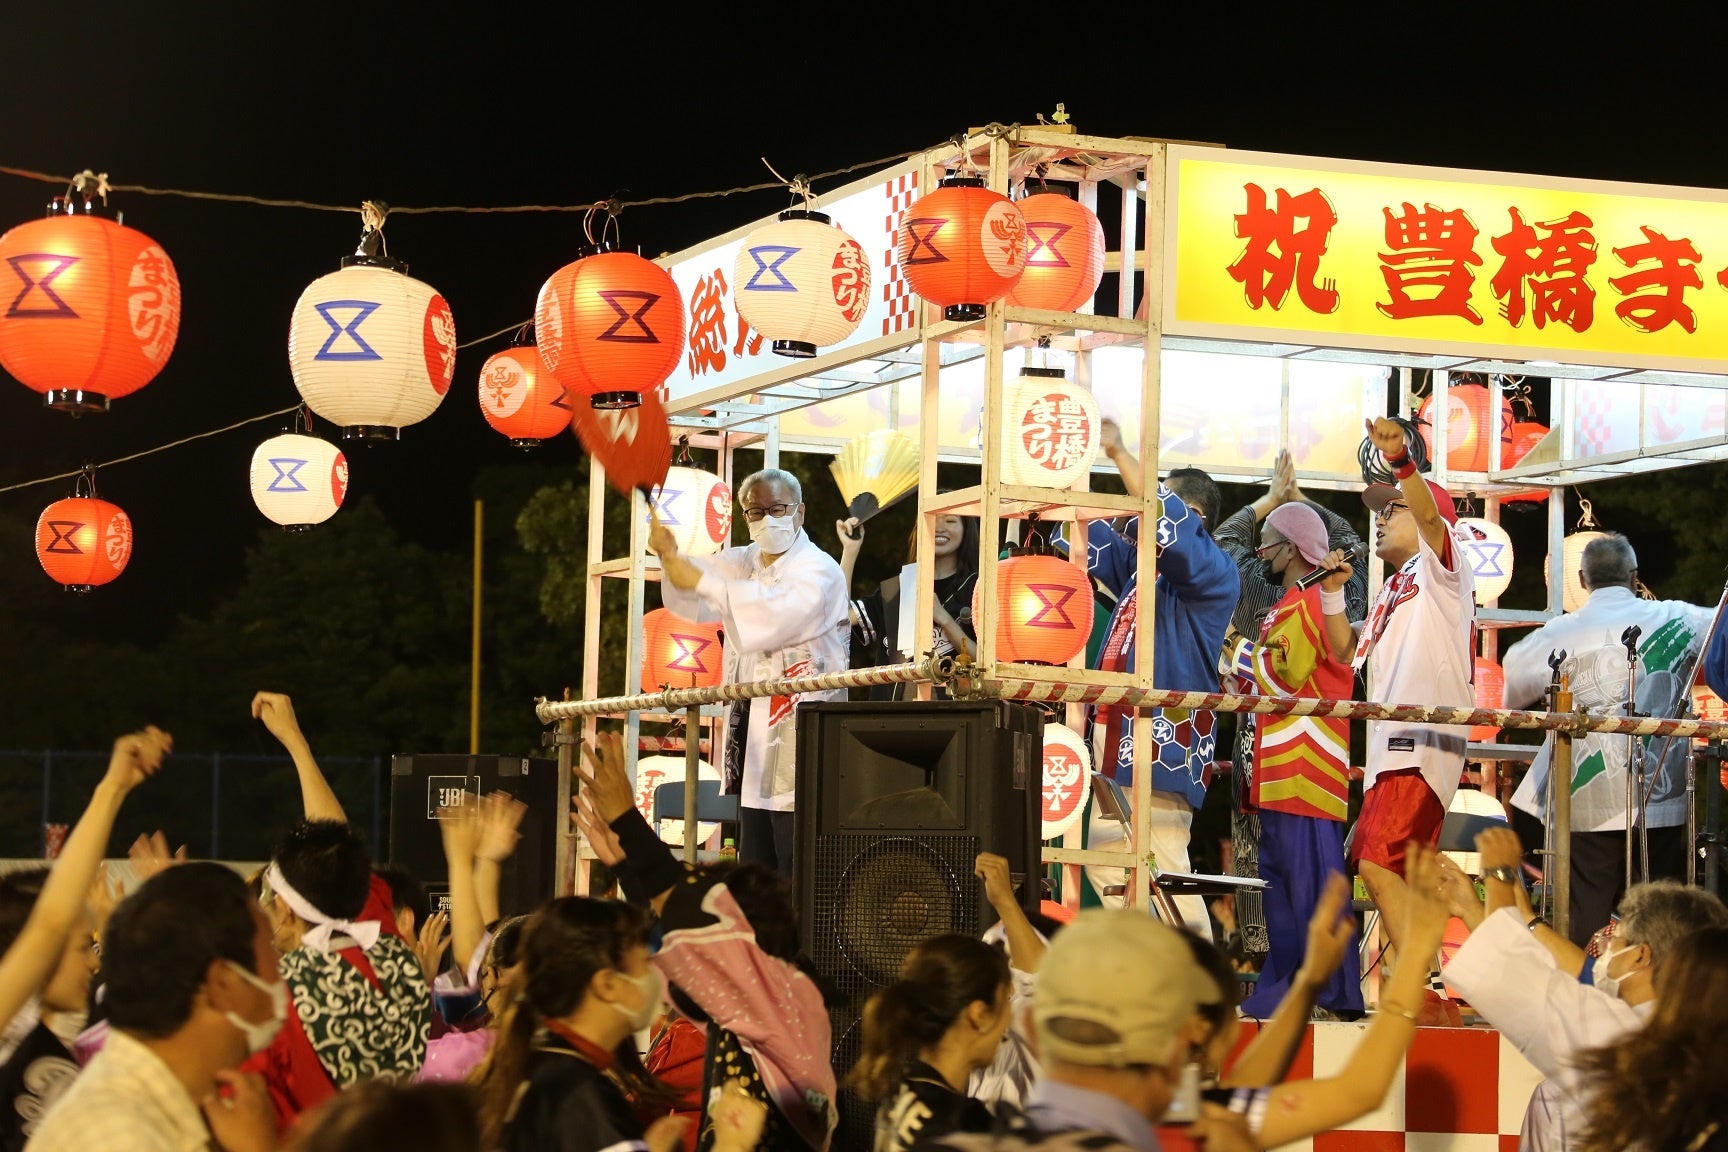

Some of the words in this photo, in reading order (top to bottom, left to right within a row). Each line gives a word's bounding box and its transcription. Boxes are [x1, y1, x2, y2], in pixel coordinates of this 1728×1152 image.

[1226, 182, 1341, 316] 祝
[1375, 201, 1728, 335] 豊橋ま
[1021, 396, 1058, 464] まつり
[1052, 397, 1087, 470] 豊橋
